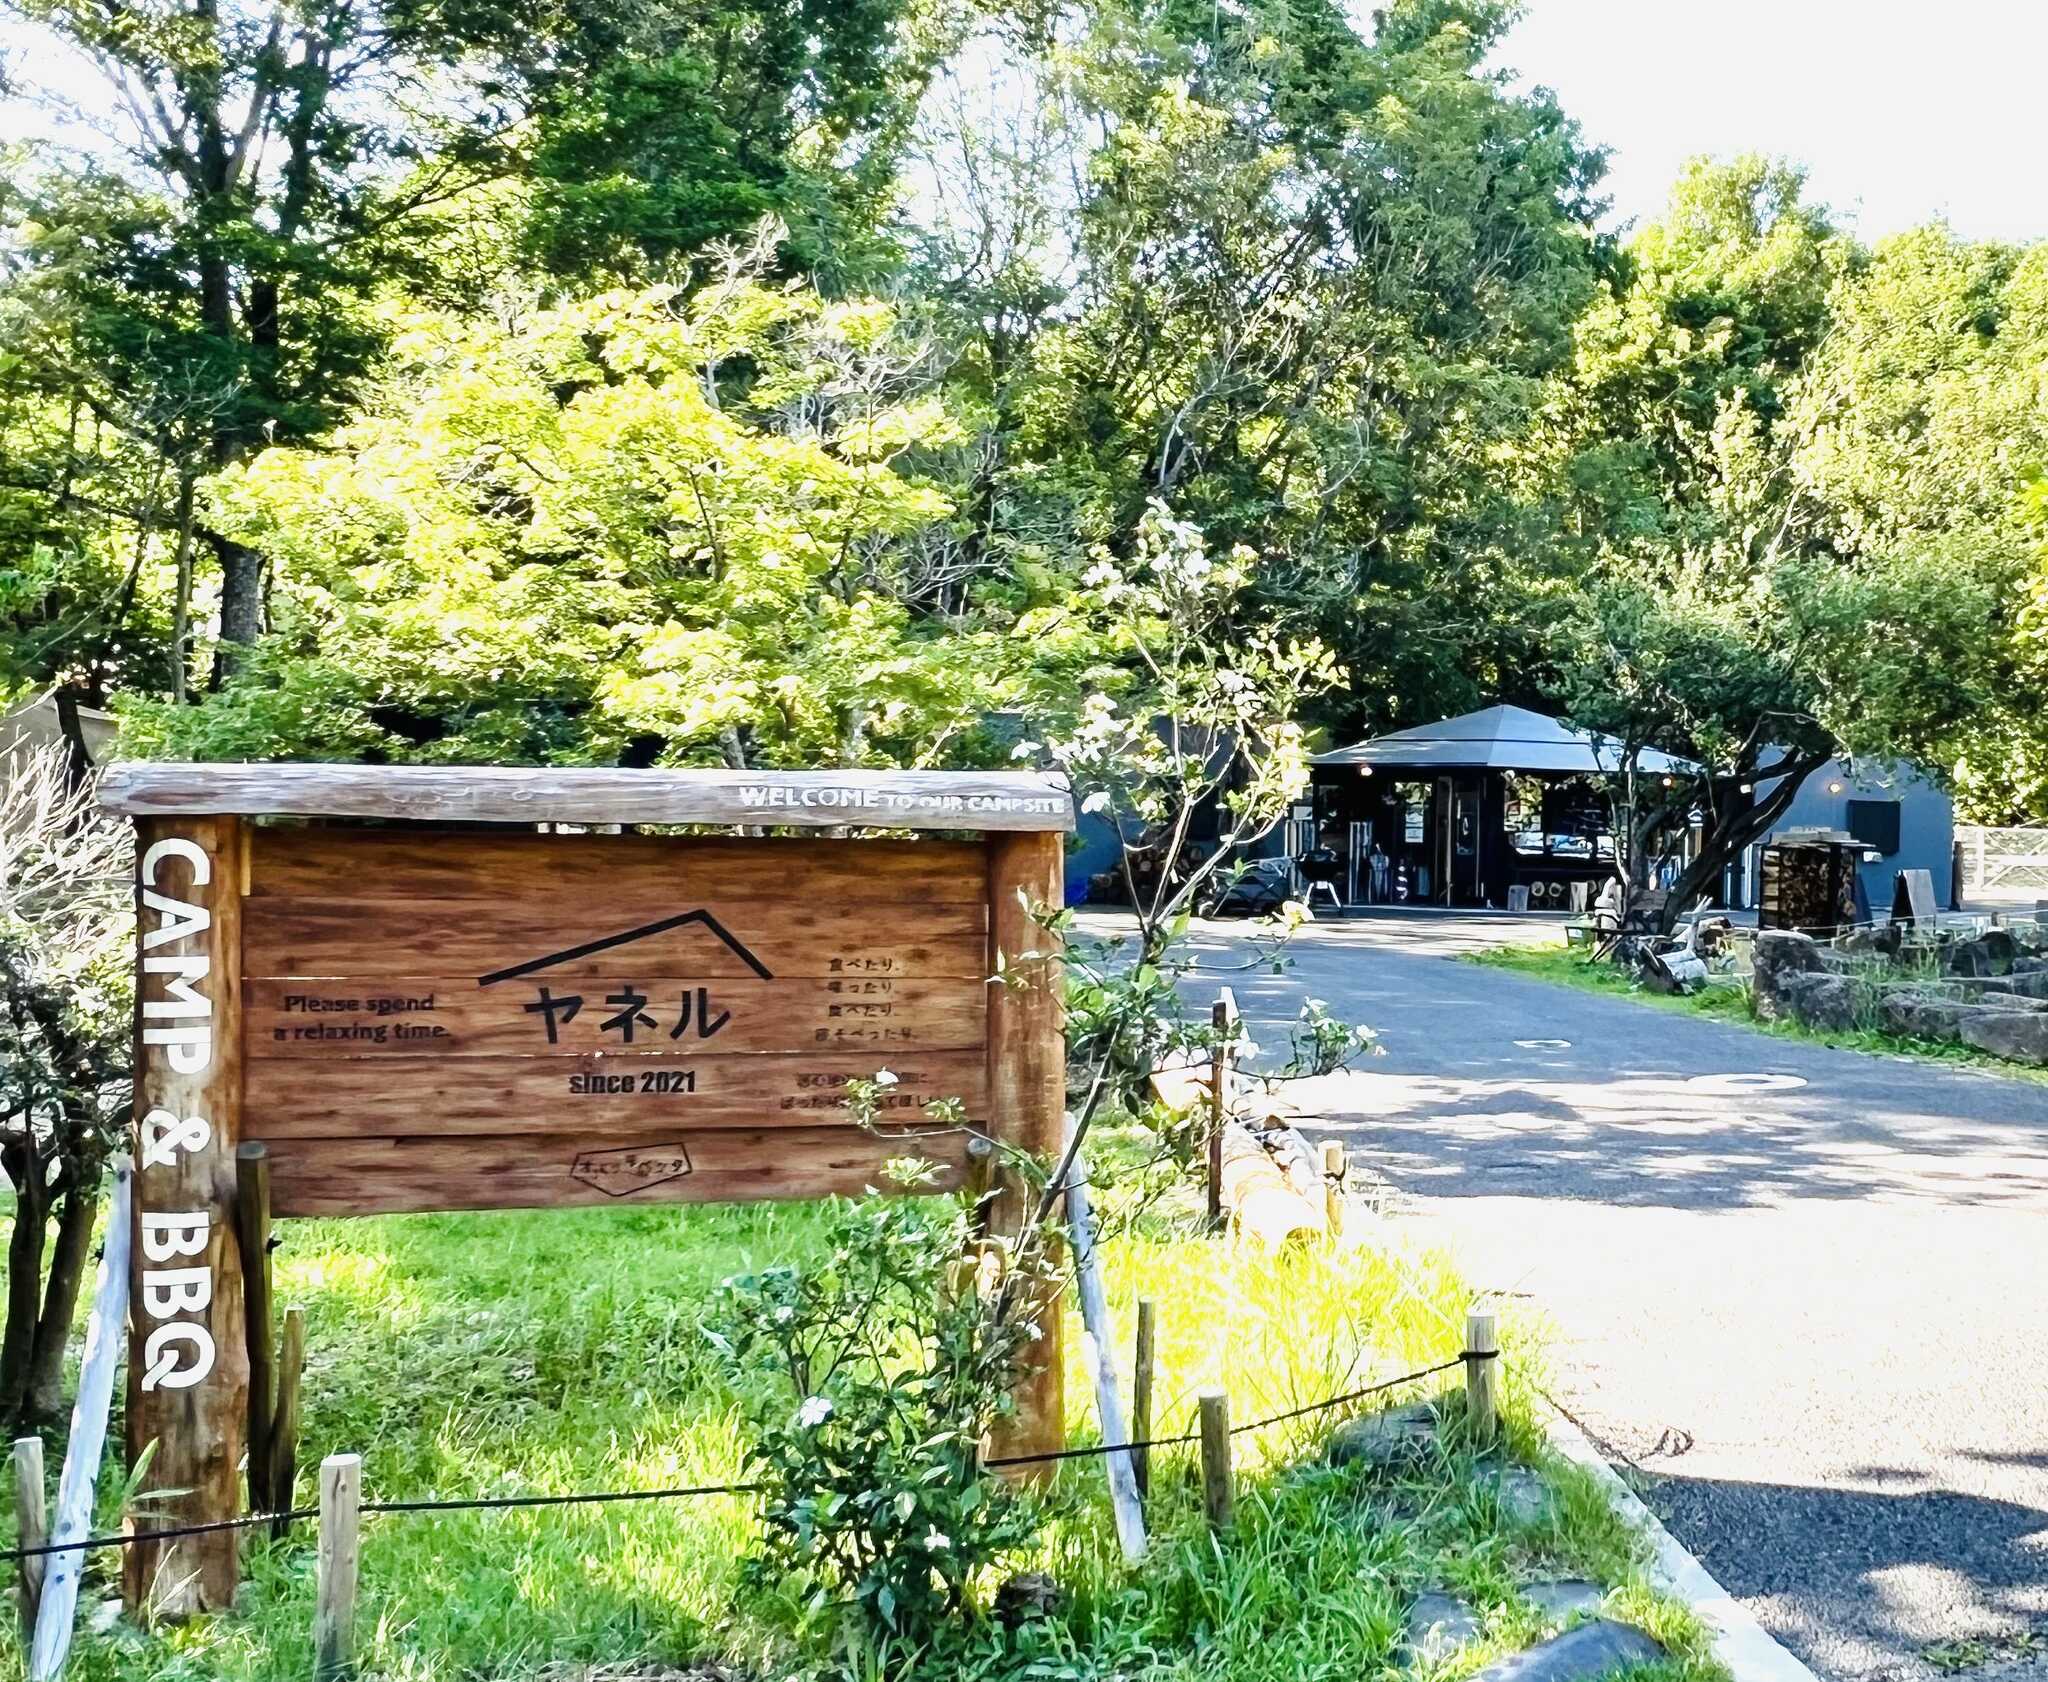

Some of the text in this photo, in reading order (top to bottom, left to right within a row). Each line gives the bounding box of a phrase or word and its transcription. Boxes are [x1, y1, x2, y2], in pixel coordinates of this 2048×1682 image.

[738, 786, 1065, 814] WELCOME TO OUR CAMPSITE
[284, 994, 435, 1016] Please spend
[523, 985, 731, 1044] ヤネル
[273, 1027, 286, 1041] a
[294, 1022, 388, 1044] relaxing
[569, 1071, 696, 1094] since 2021
[141, 837, 216, 1392] CAMP & BBQ
